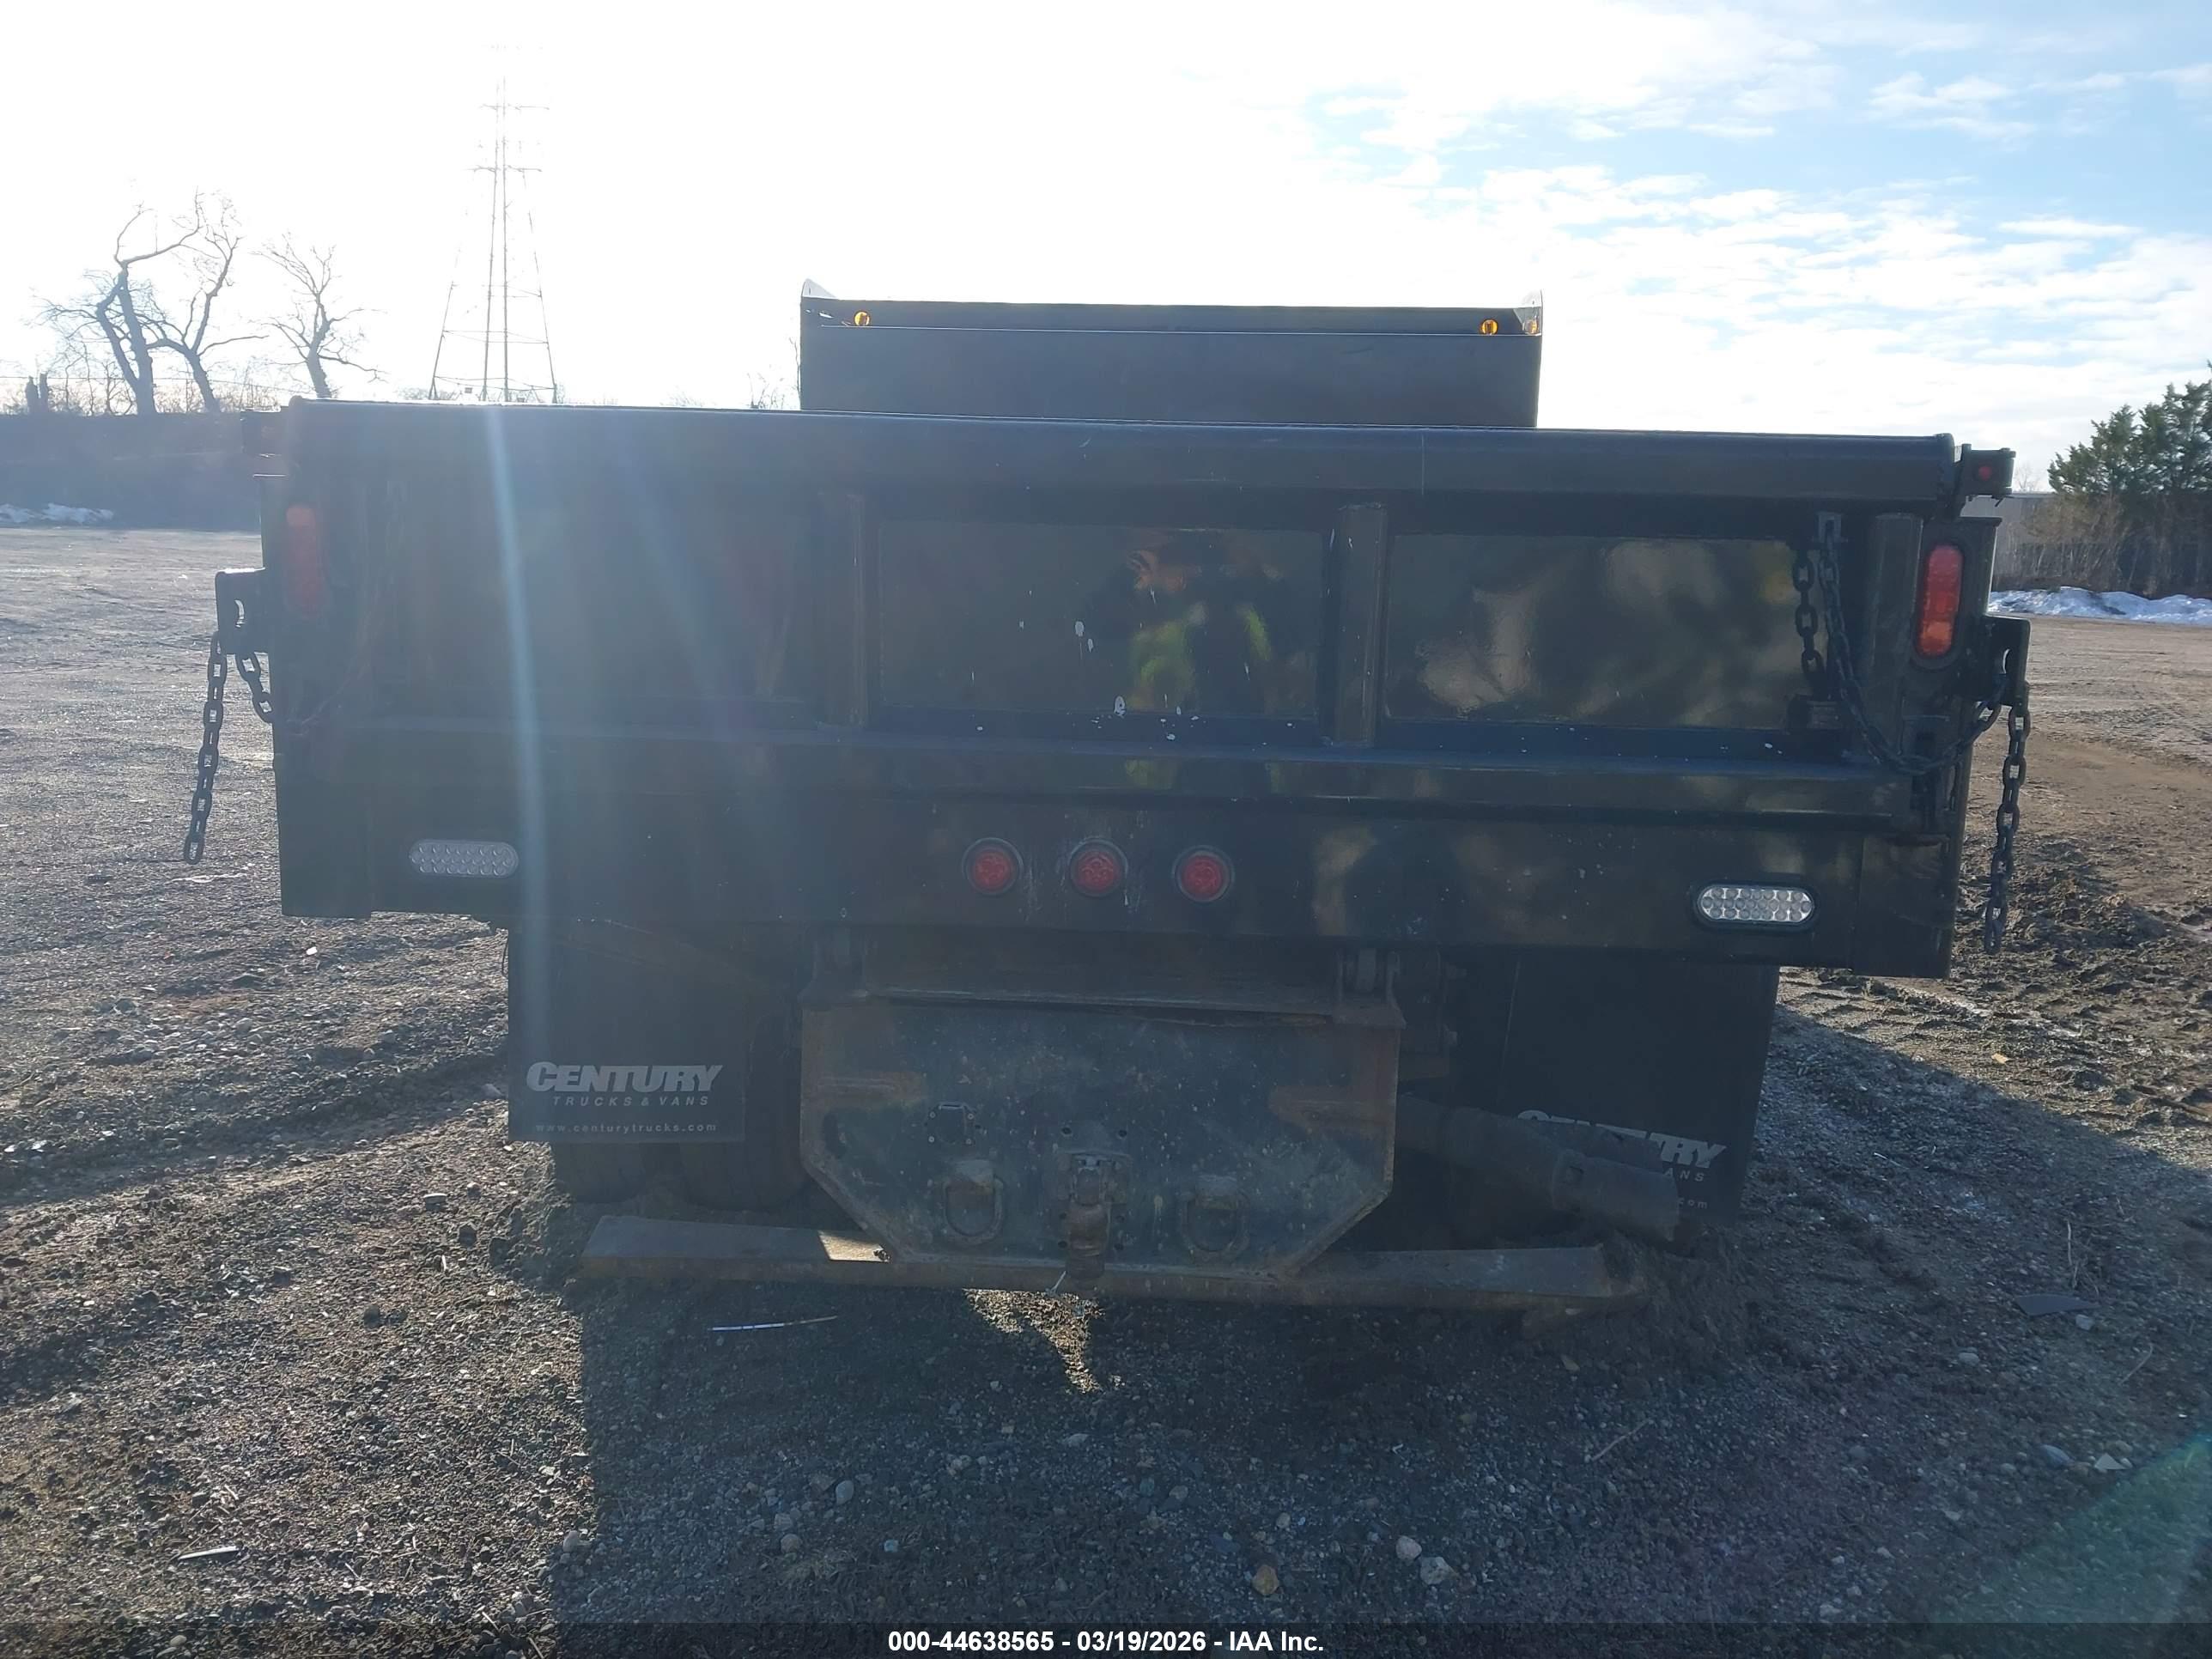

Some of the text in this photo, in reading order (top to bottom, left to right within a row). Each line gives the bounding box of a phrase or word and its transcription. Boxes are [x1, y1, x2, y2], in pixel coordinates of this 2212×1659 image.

[526, 1061, 723, 1093] CENTURY
[552, 1096, 709, 1107] TRUCKS & VANS
[535, 1122, 717, 1134] www.centurytrucks.com
[1664, 1168, 1705, 1182] ANS
